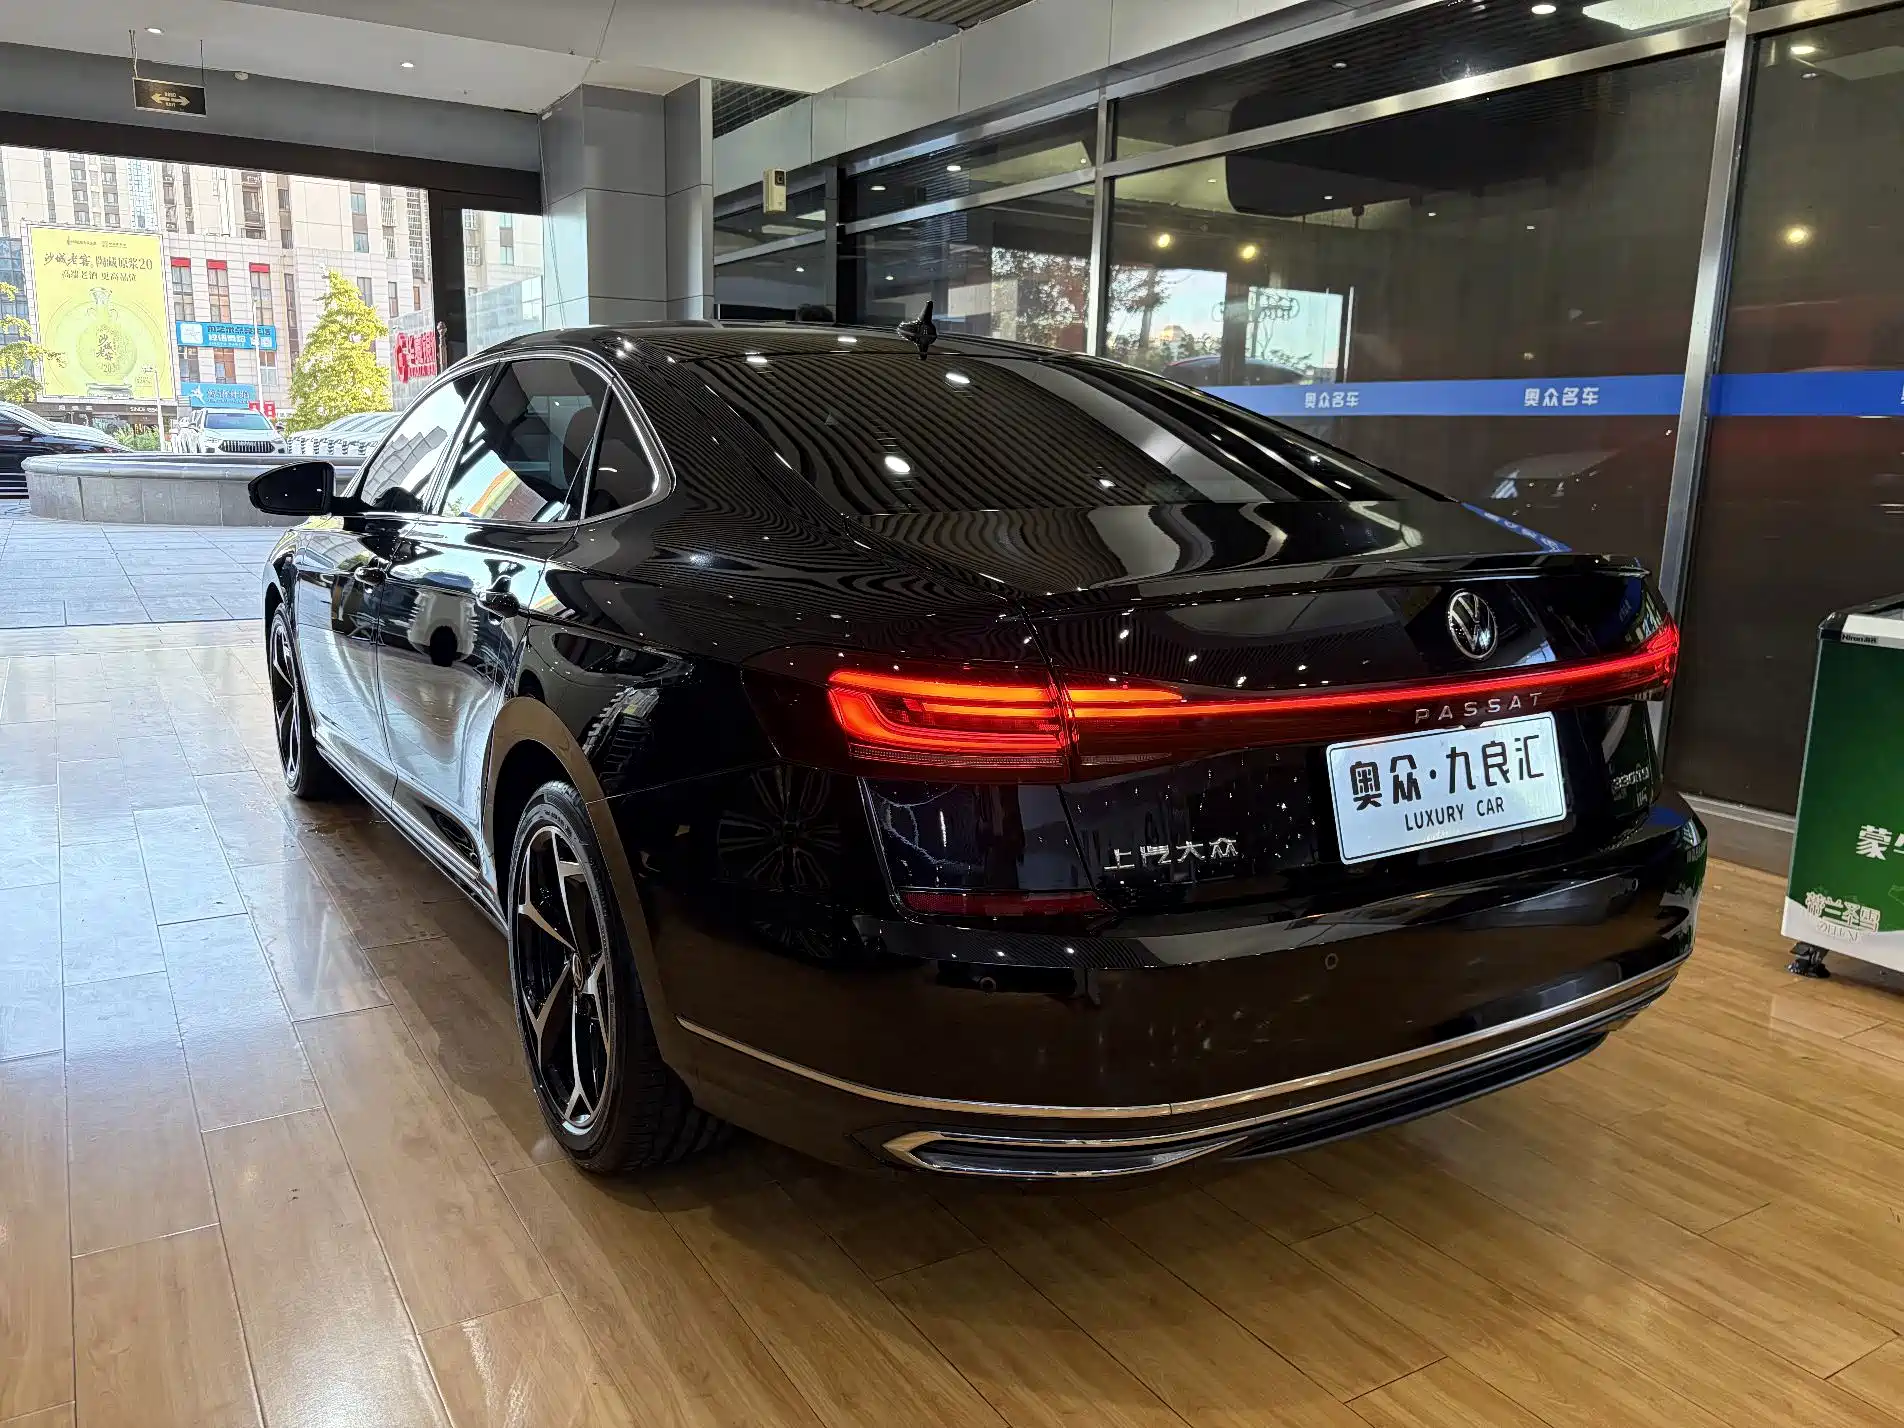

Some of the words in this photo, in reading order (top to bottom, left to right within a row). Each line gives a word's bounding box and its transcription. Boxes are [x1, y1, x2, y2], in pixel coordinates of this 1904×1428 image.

[1304, 391, 1360, 409] 奥众名车
[1524, 386, 1600, 407] 奥众名车
[1414, 692, 1542, 724] PASSAT
[1349, 734, 1545, 811] 奥众·九良汇
[1404, 803, 1464, 831] LUXURY
[1476, 796, 1505, 817] CAR
[1104, 837, 1239, 871] 上汽大众
